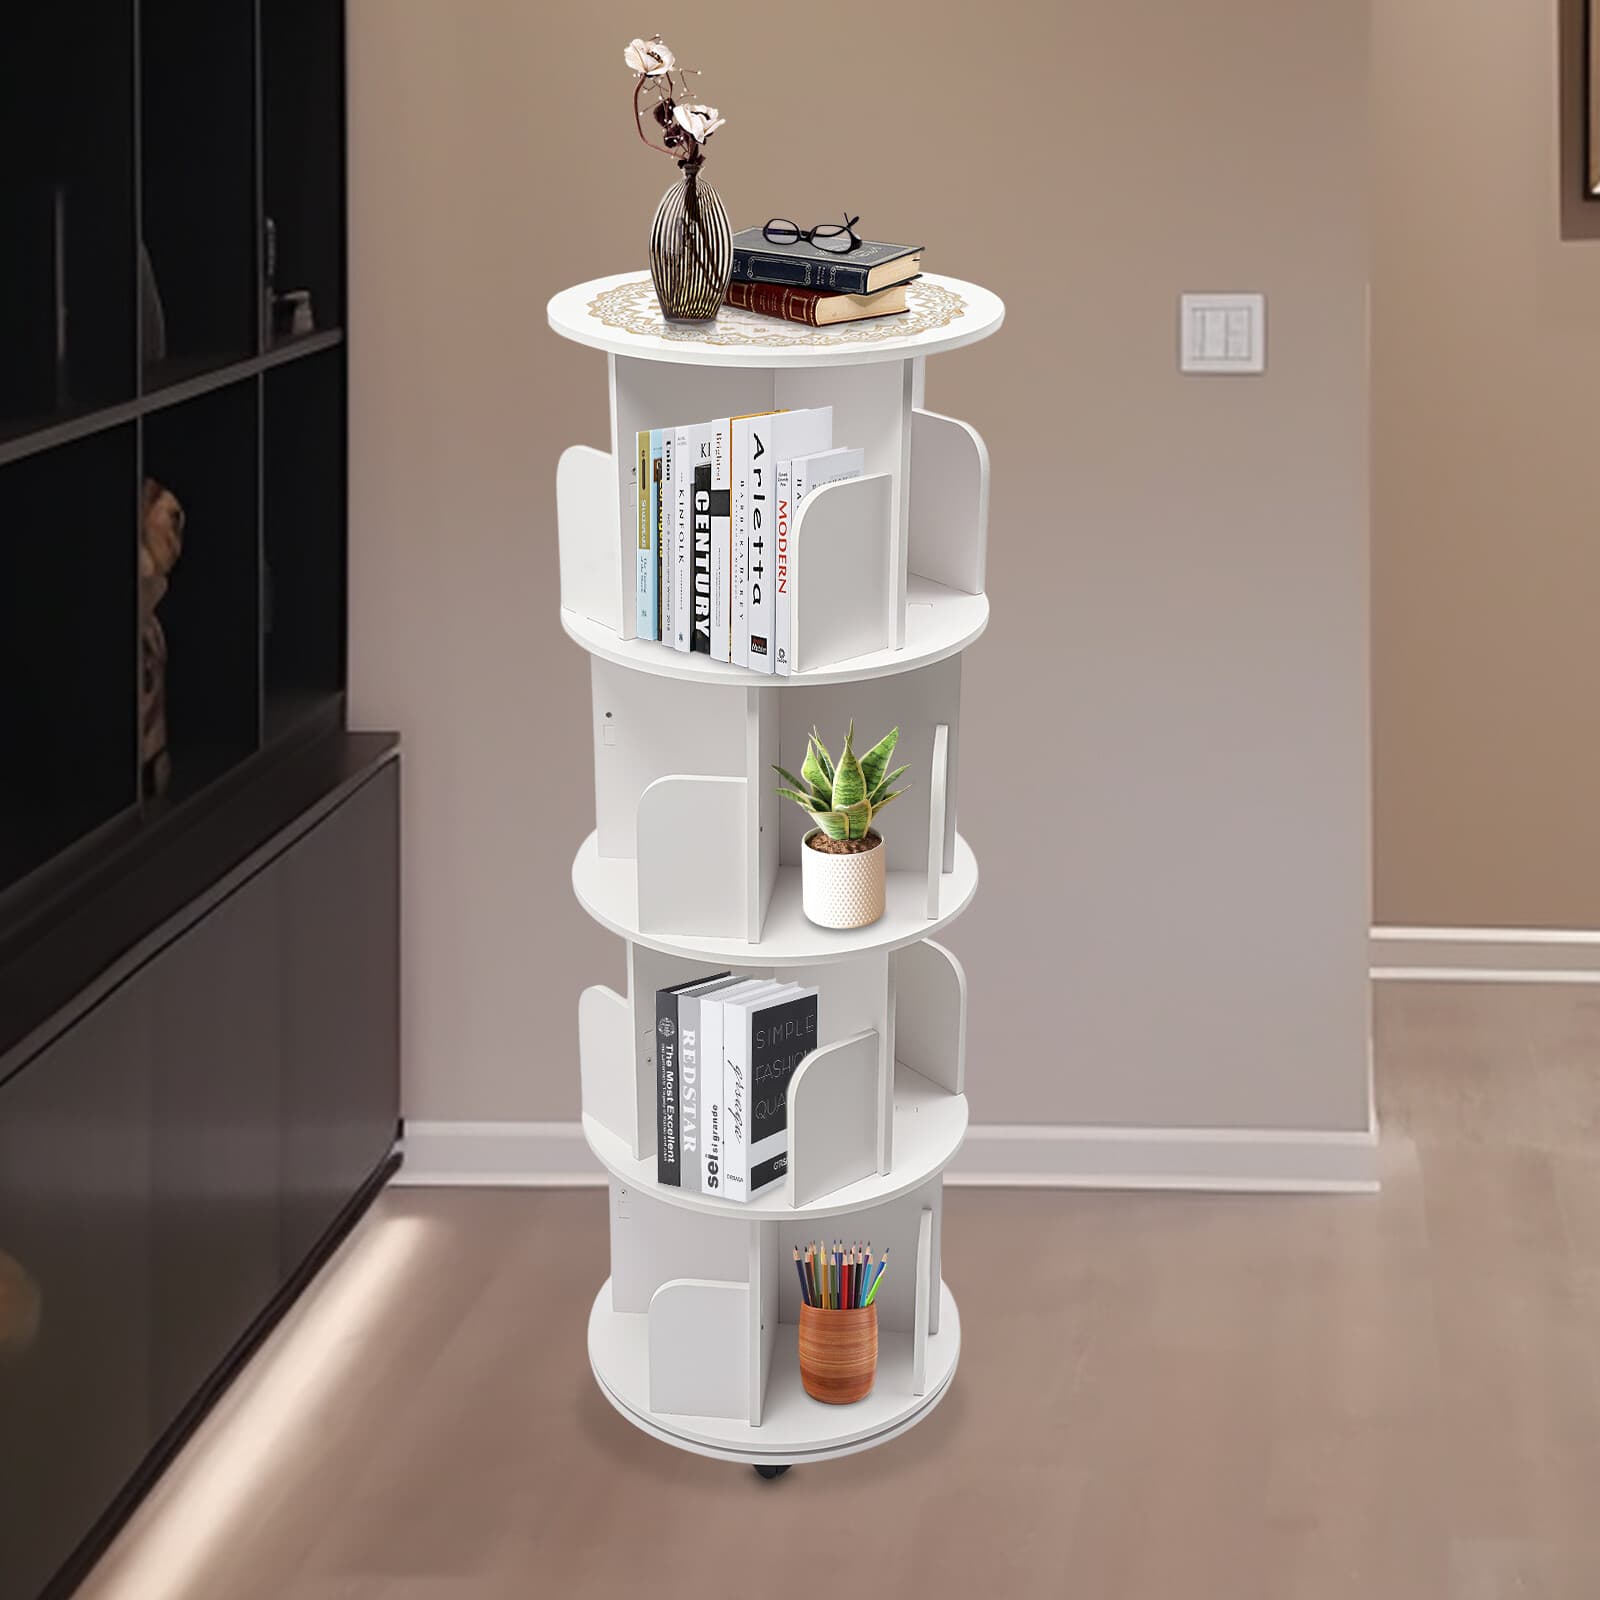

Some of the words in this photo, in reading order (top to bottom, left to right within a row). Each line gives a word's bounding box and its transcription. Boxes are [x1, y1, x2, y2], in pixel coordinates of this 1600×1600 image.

[753, 433, 765, 605] Arletta
[778, 500, 787, 594] MODERN
[696, 491, 710, 637] CENTURY
[756, 1014, 814, 1049] SIMPLE
[682, 1029, 697, 1153] REDSTAR
[711, 1104, 719, 1141] grande
[667, 1105, 675, 1163] Excellent
[705, 1154, 718, 1189] sei
